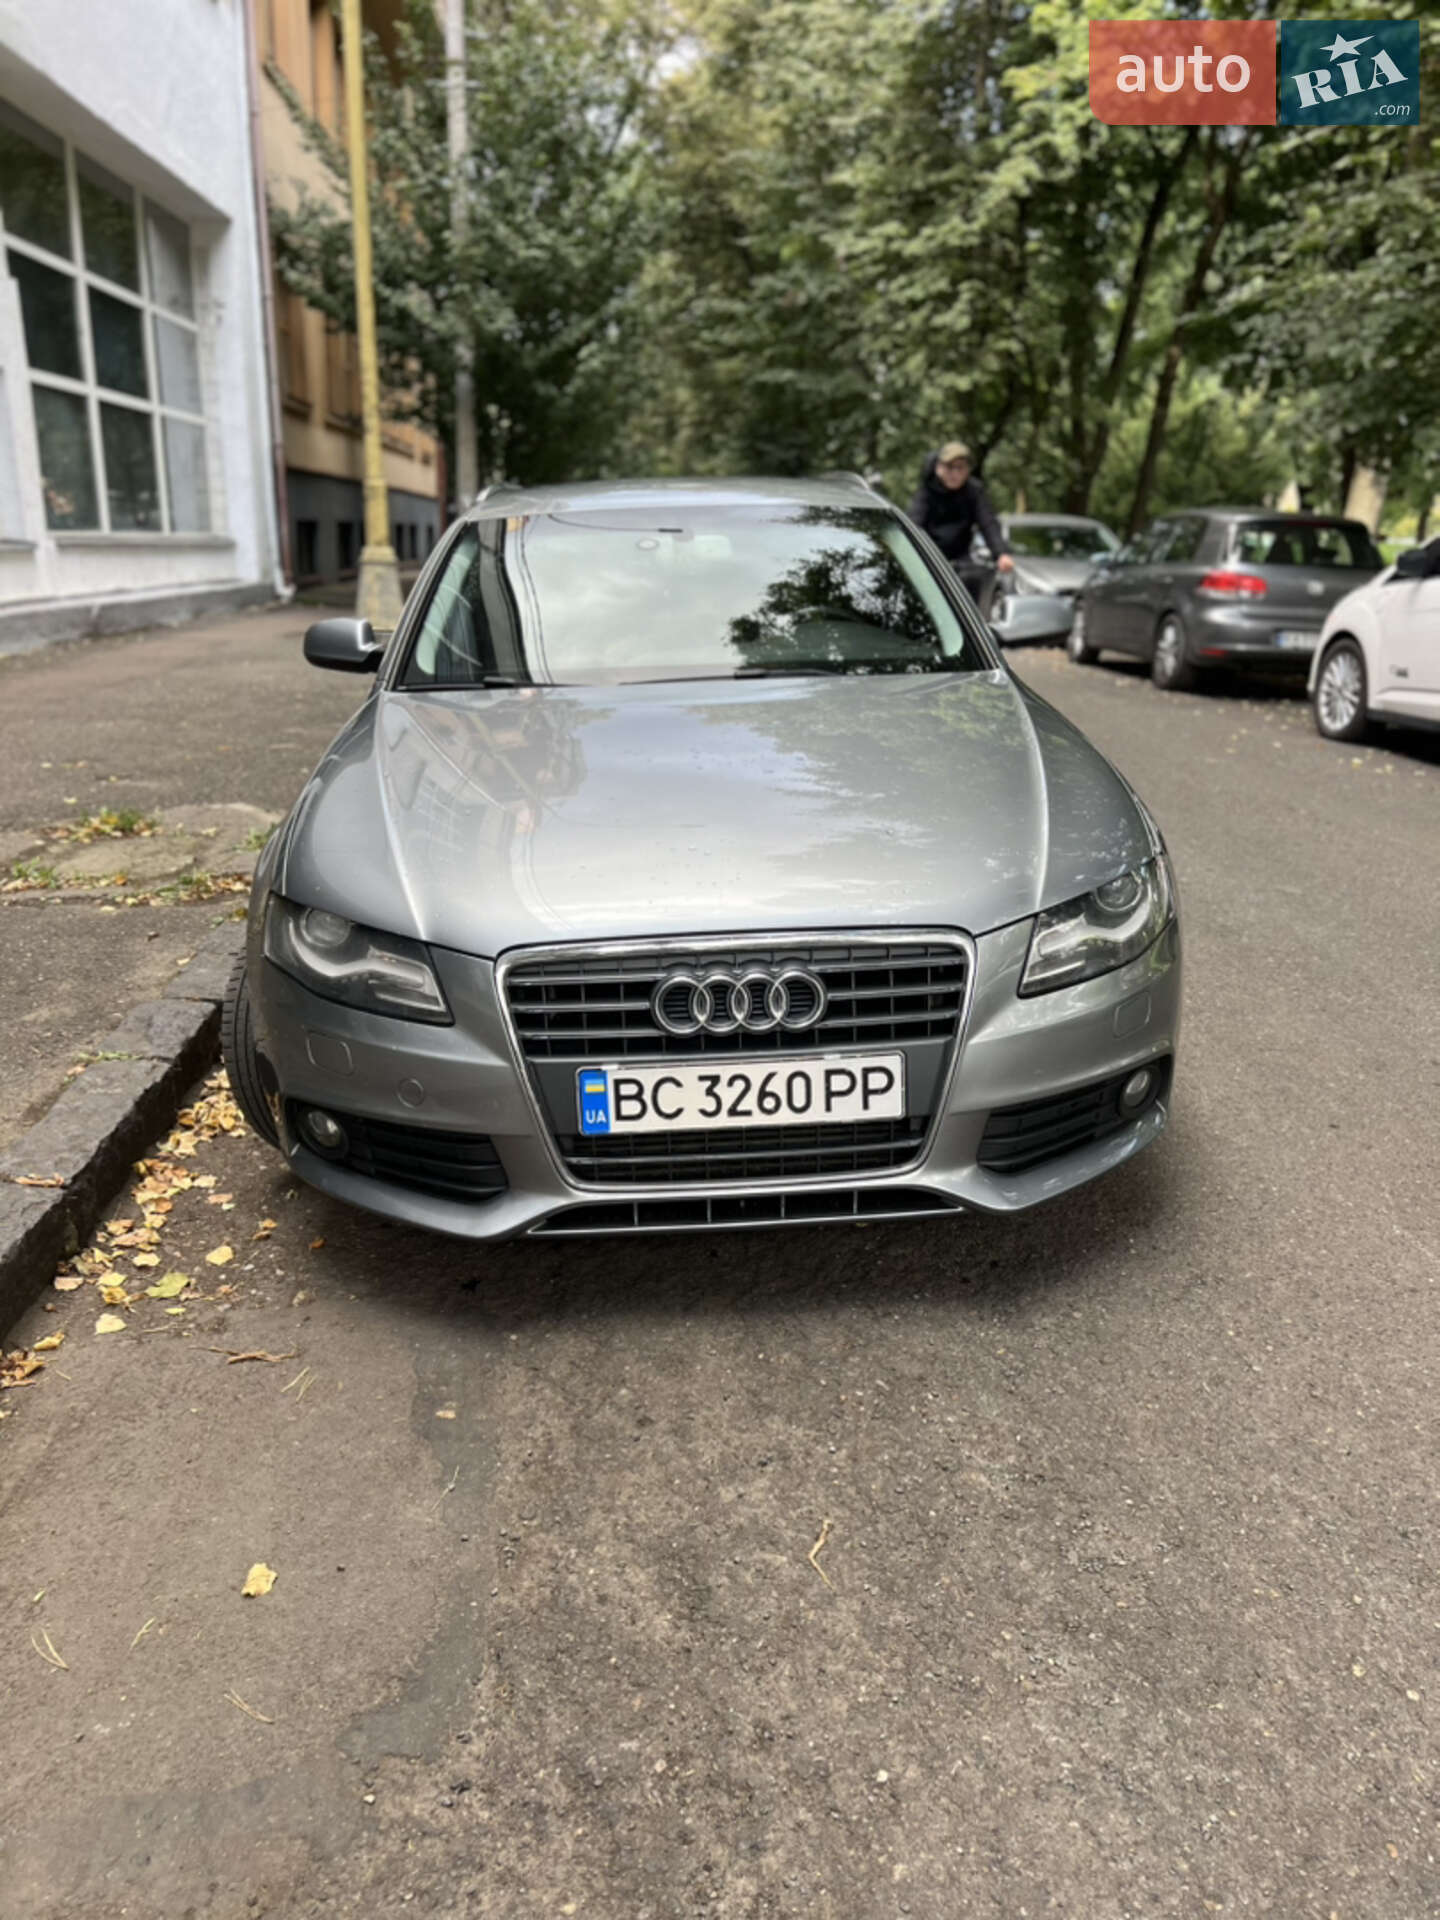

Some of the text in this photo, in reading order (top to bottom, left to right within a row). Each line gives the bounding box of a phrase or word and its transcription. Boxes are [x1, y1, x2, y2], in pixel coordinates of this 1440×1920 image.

[613, 1066, 895, 1122] BC 3260 PP
[585, 1109, 607, 1124] UA
